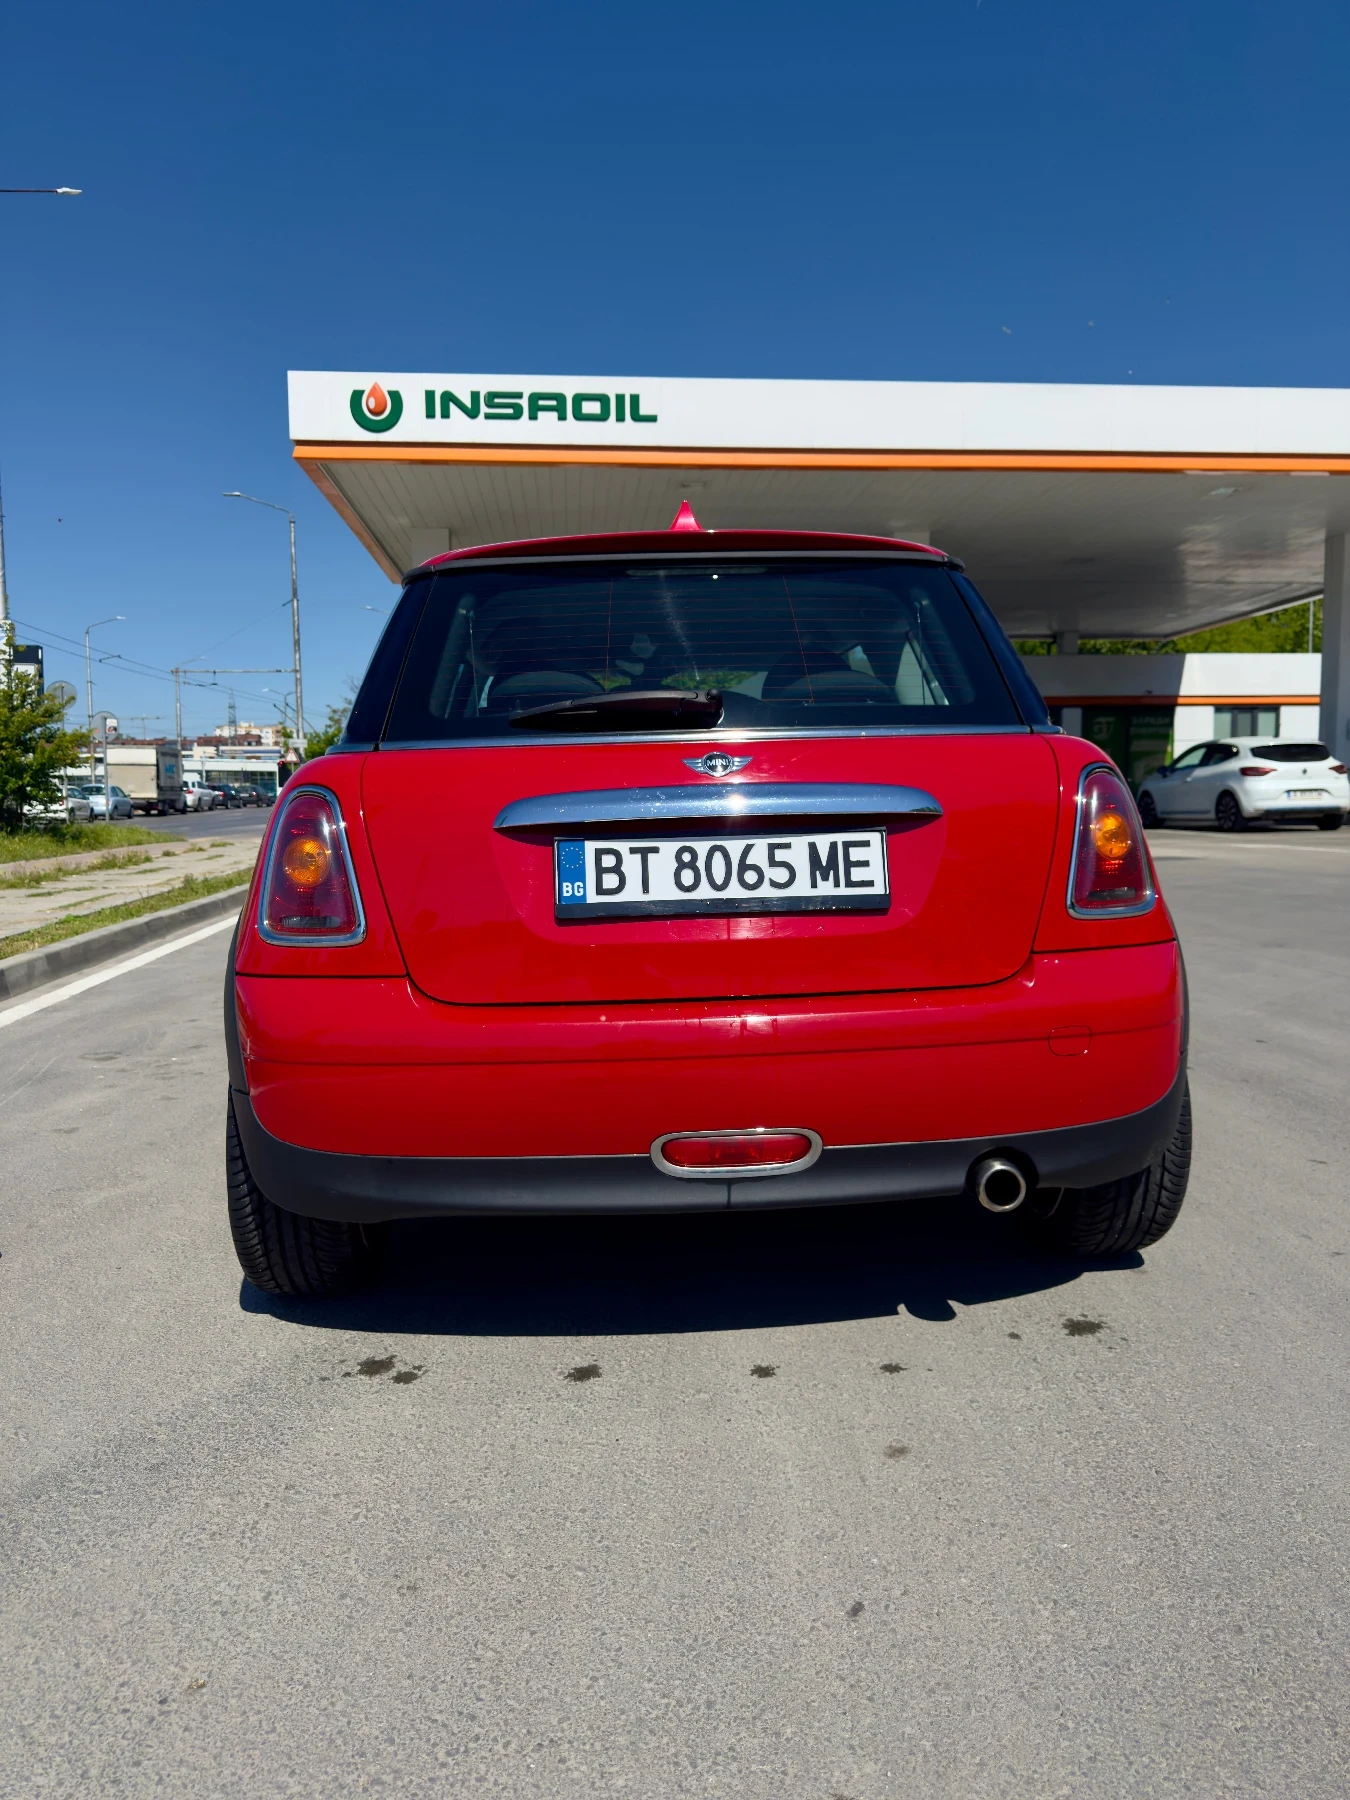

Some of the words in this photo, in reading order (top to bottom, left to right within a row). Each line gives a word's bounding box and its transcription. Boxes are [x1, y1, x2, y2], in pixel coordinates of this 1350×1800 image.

[424, 389, 658, 423] INSAOIL
[706, 758, 729, 767] MINI
[594, 846, 660, 895] BT
[673, 843, 797, 893] 8065
[808, 840, 875, 888] ME
[562, 882, 584, 896] BG
